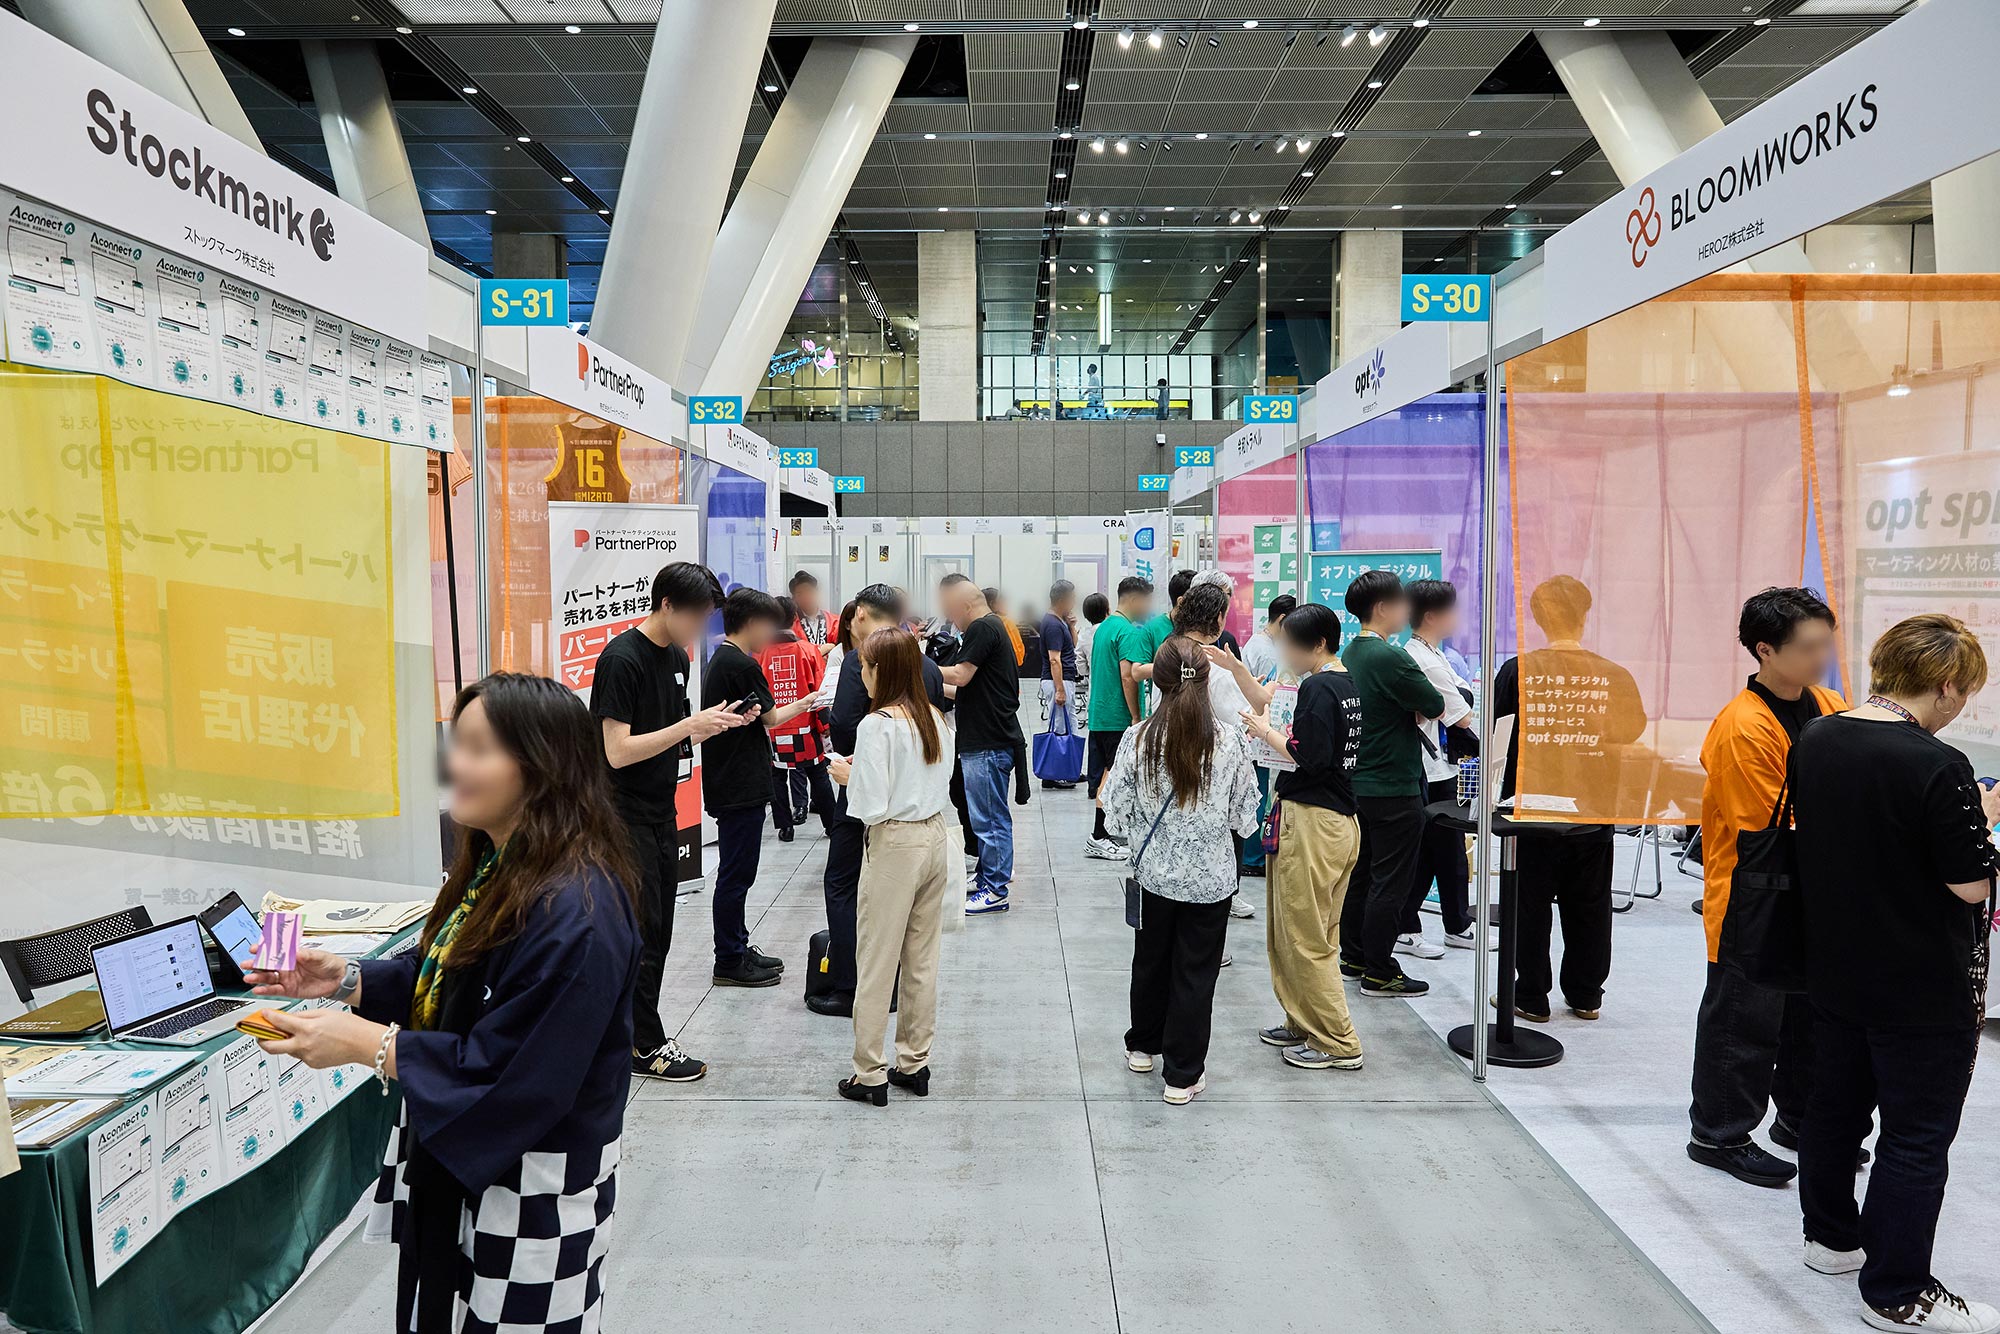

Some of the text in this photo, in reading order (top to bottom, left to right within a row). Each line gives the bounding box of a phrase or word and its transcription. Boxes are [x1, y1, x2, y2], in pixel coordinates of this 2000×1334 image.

[86, 88, 305, 247] Stockmark
[1672, 84, 1878, 231] BLOOMWORKS
[10, 205, 63, 232] Aconnect
[91, 232, 132, 257] Aconnect
[183, 226, 276, 278] ストックマーク株式会社
[1698, 218, 1765, 261] HEROZ株式会社
[156, 258, 196, 280] Aconnect
[491, 288, 553, 319] S-31
[1412, 283, 1481, 313] S-30
[768, 356, 813, 378] Saigon
[593, 356, 644, 409] PartnerProp
[1355, 364, 1370, 398] opt
[694, 401, 735, 419] S-32
[1250, 400, 1292, 419] S-29
[574, 449, 606, 488] 16
[782, 451, 813, 465] S-33
[1179, 450, 1211, 464] S-28
[836, 480, 861, 490] S-34
[1142, 478, 1167, 488] S-27
[1103, 519, 1127, 528] CRA
[1865, 487, 1932, 542] opt
[595, 537, 677, 553] PartnerProp
[563, 575, 650, 605] パートナーが
[564, 623, 635, 657] パート
[773, 682, 797, 690] OPEN
[1570, 676, 1610, 686] デジタル
[1526, 690, 1609, 700] マーケティング専門
[1527, 717, 1586, 726] 支援サービス
[1527, 731, 1600, 746] opt spring
[223, 1039, 255, 1065] Aconnect
[164, 1073, 201, 1103] Aconnect
[97, 1112, 140, 1148] Aconnect
